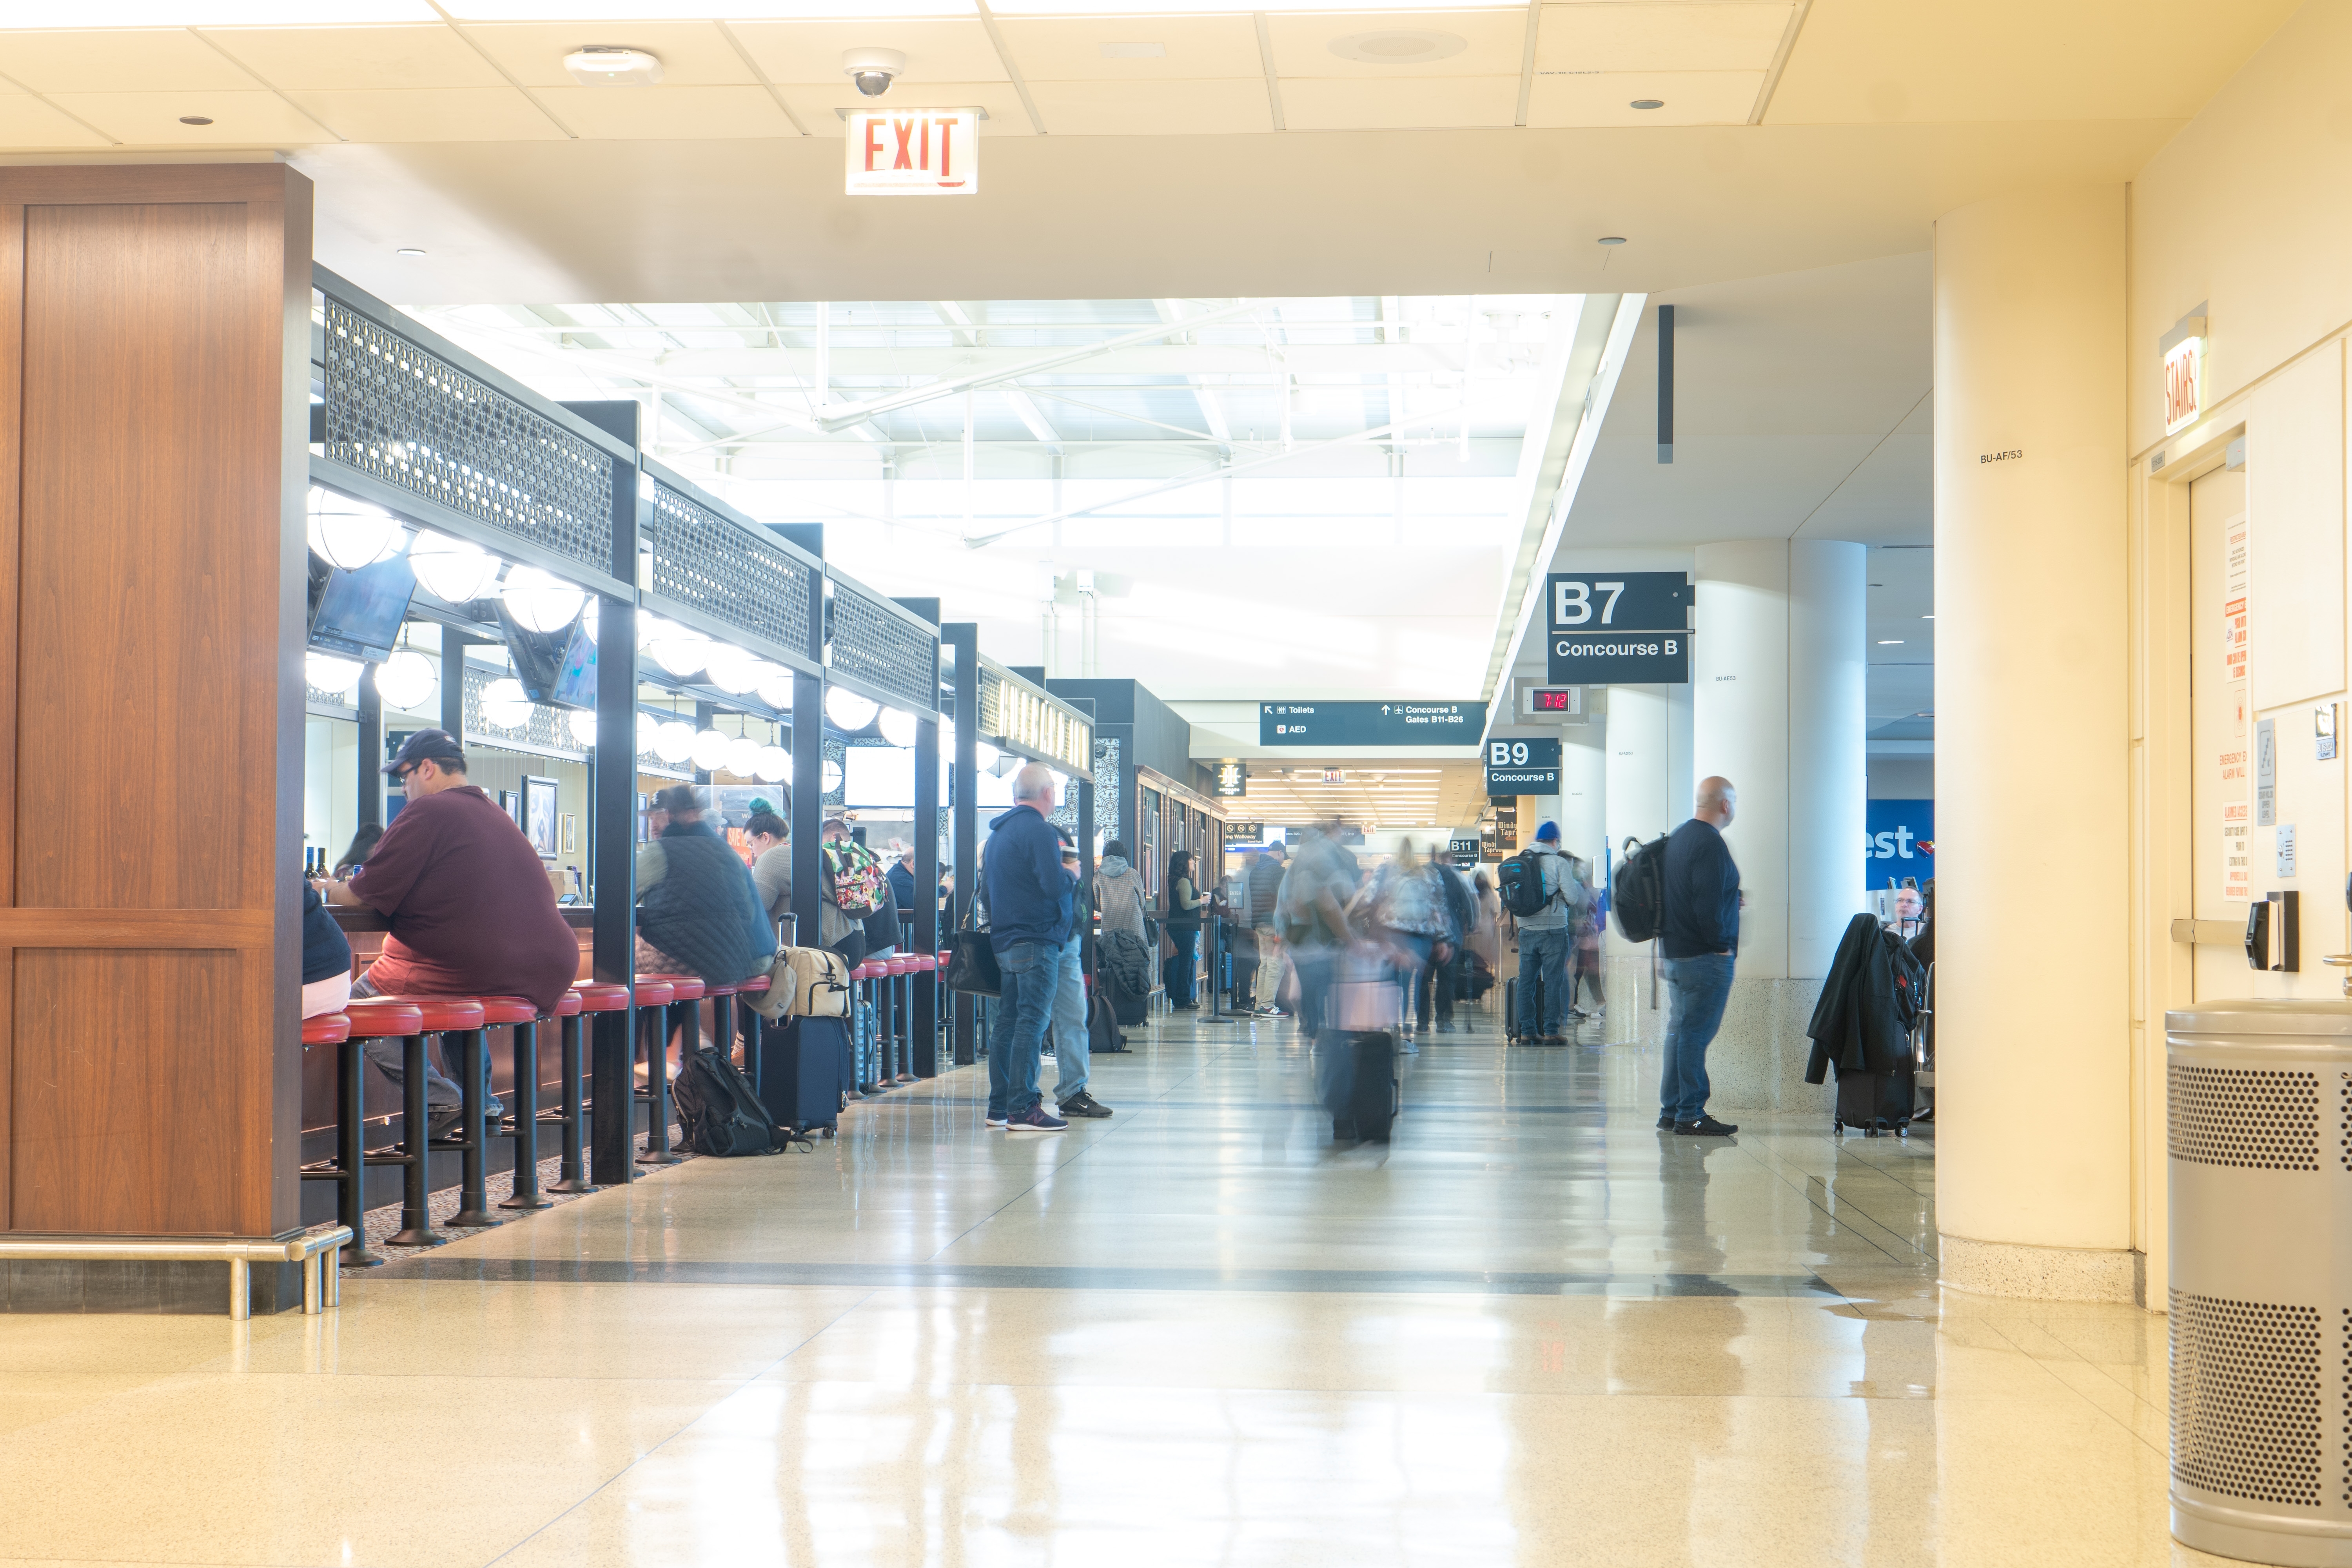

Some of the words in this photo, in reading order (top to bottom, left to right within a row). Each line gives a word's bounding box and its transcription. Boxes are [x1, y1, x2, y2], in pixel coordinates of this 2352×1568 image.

[865, 118, 958, 176] EXIT
[2165, 349, 2194, 426] STAIRS
[1981, 450, 2022, 463] BU-AF/53
[1555, 582, 1624, 624] B7
[1556, 641, 1658, 656] Concourse
[1665, 640, 1678, 655] B
[1544, 693, 1567, 708] 7:12
[1491, 742, 1529, 765] B9
[2220, 752, 2241, 766] EMERGENCY
[1325, 771, 1342, 781] EXIT
[1492, 773, 1544, 782] Concourse
[1547, 773, 1554, 781] B
[2223, 768, 2235, 780] ALARM
[2236, 767, 2245, 778] WILL
[729, 828, 740, 846] SAVE
[1451, 841, 1470, 851] B11
